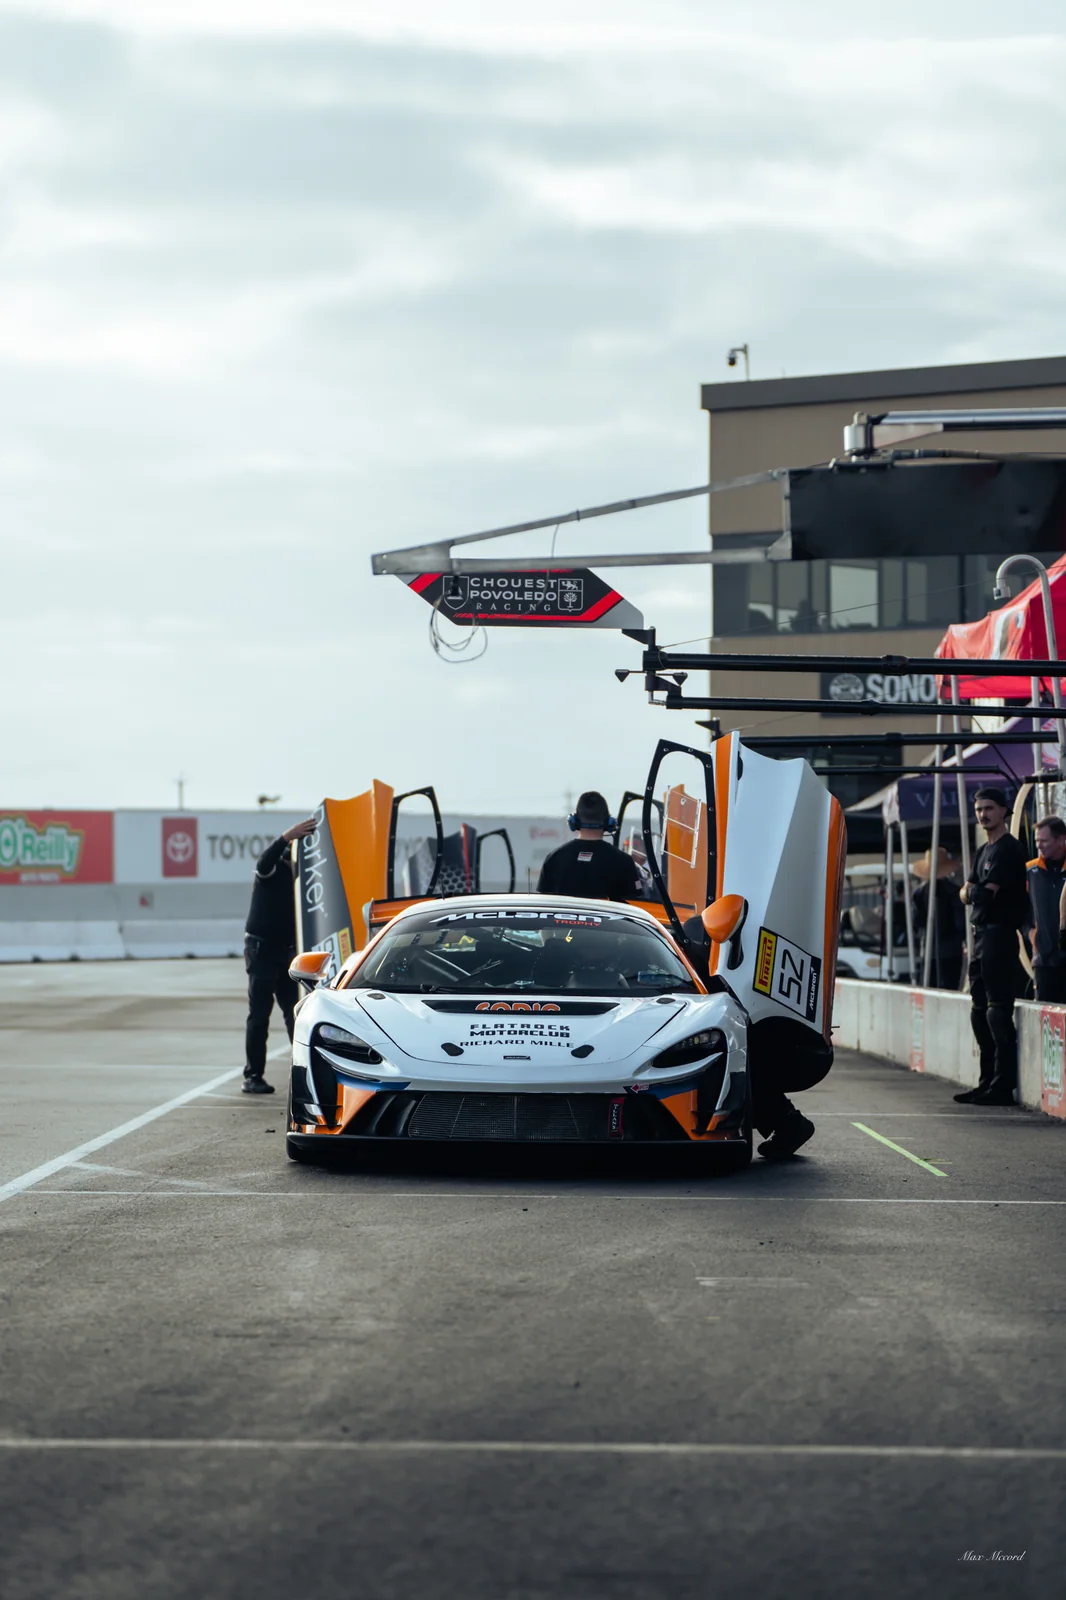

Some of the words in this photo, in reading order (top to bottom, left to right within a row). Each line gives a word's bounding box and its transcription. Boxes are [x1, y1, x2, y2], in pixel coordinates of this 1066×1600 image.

[470, 577, 557, 587] CHOUEST
[470, 590, 557, 601] POVOLEDO
[476, 602, 551, 612] RACING
[555, 919, 601, 928] TROPHY
[758, 937, 773, 988] PIRELLI
[778, 949, 804, 1006] 52
[470, 1023, 570, 1031] FLATROCK
[470, 1030, 570, 1038] MOTORCLUB
[460, 1039, 525, 1047] RICHARD
[530, 1040, 574, 1048] MILLE
